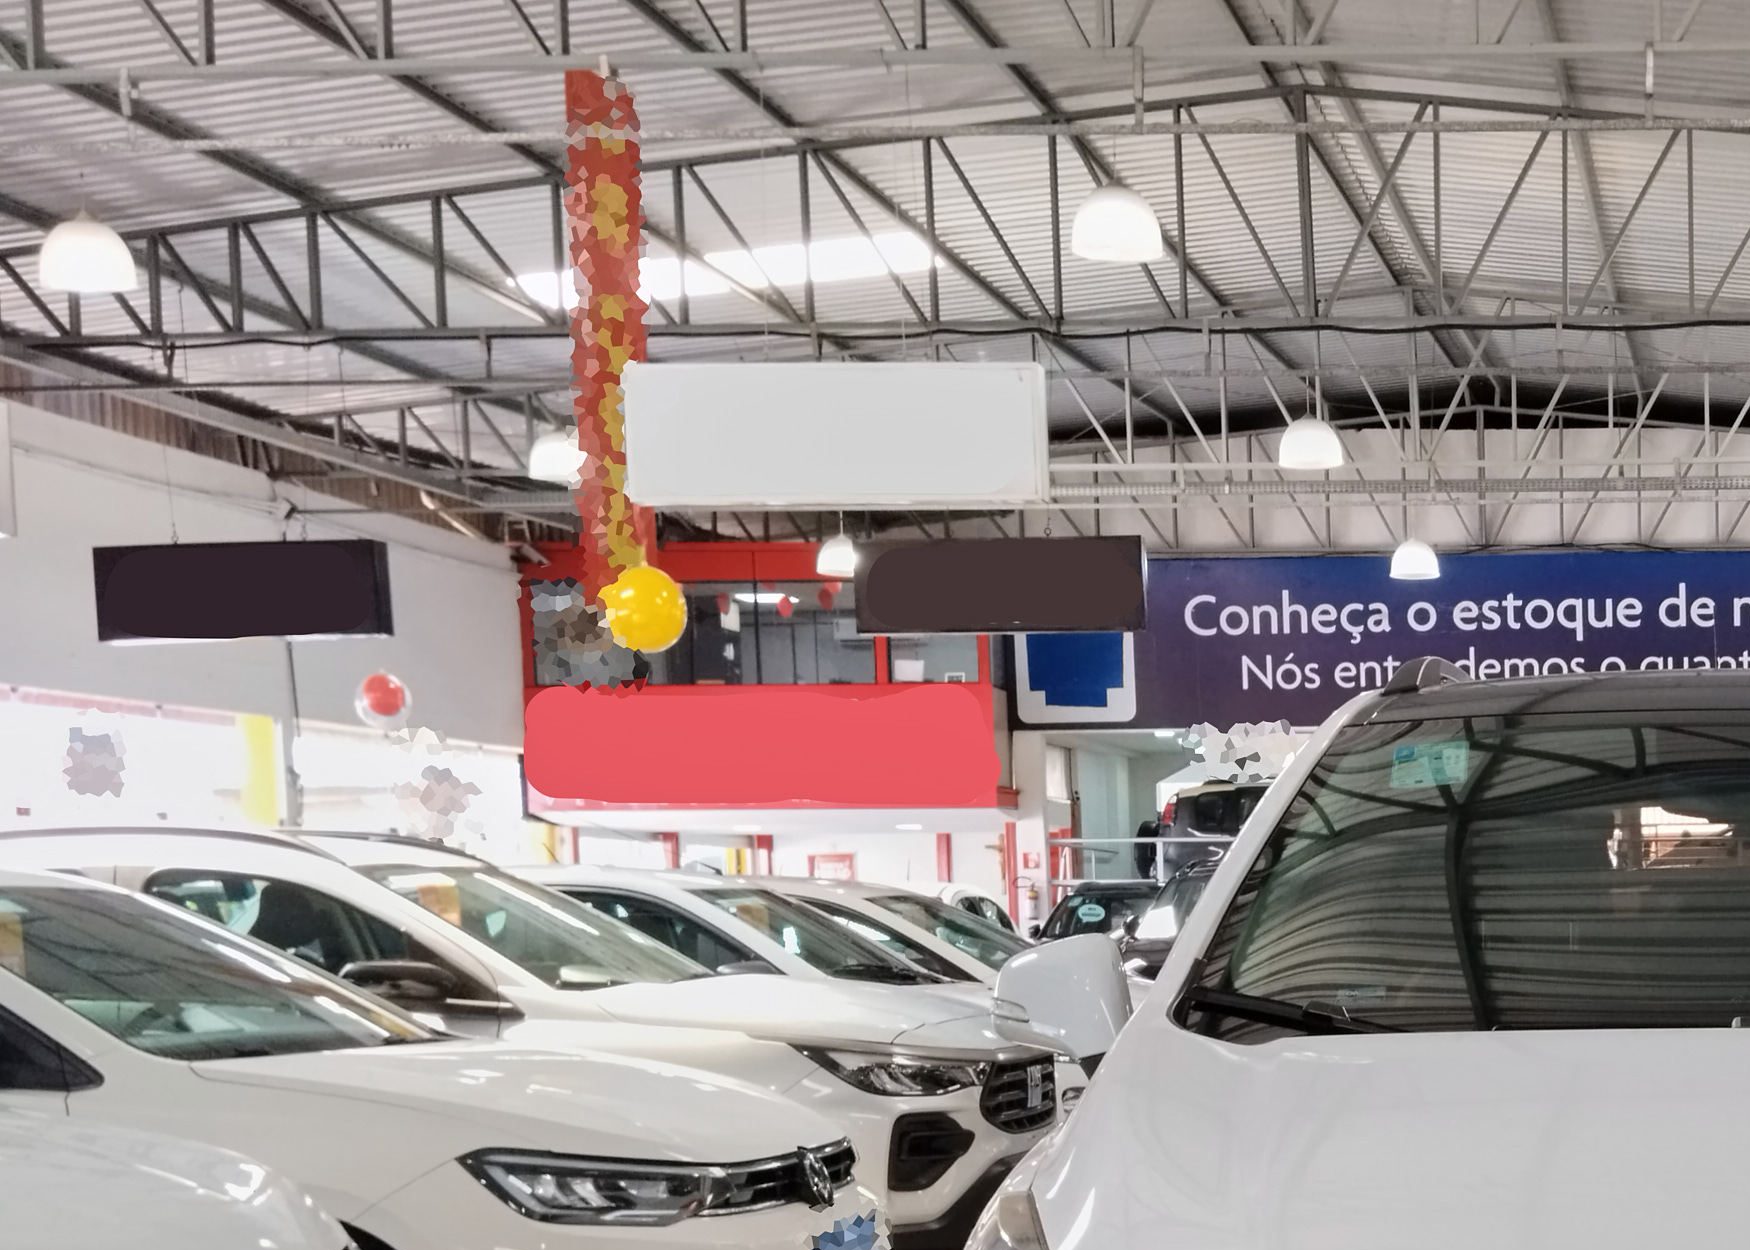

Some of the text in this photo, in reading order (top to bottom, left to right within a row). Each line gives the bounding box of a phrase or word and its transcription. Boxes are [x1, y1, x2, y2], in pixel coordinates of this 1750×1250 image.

[1184, 590, 1392, 645] Conheça
[1407, 601, 1437, 632] o
[1452, 592, 1643, 641] estoque
[1658, 582, 1716, 628] de
[1241, 652, 1321, 690] Nós
[1334, 646, 1586, 688] entdemos
